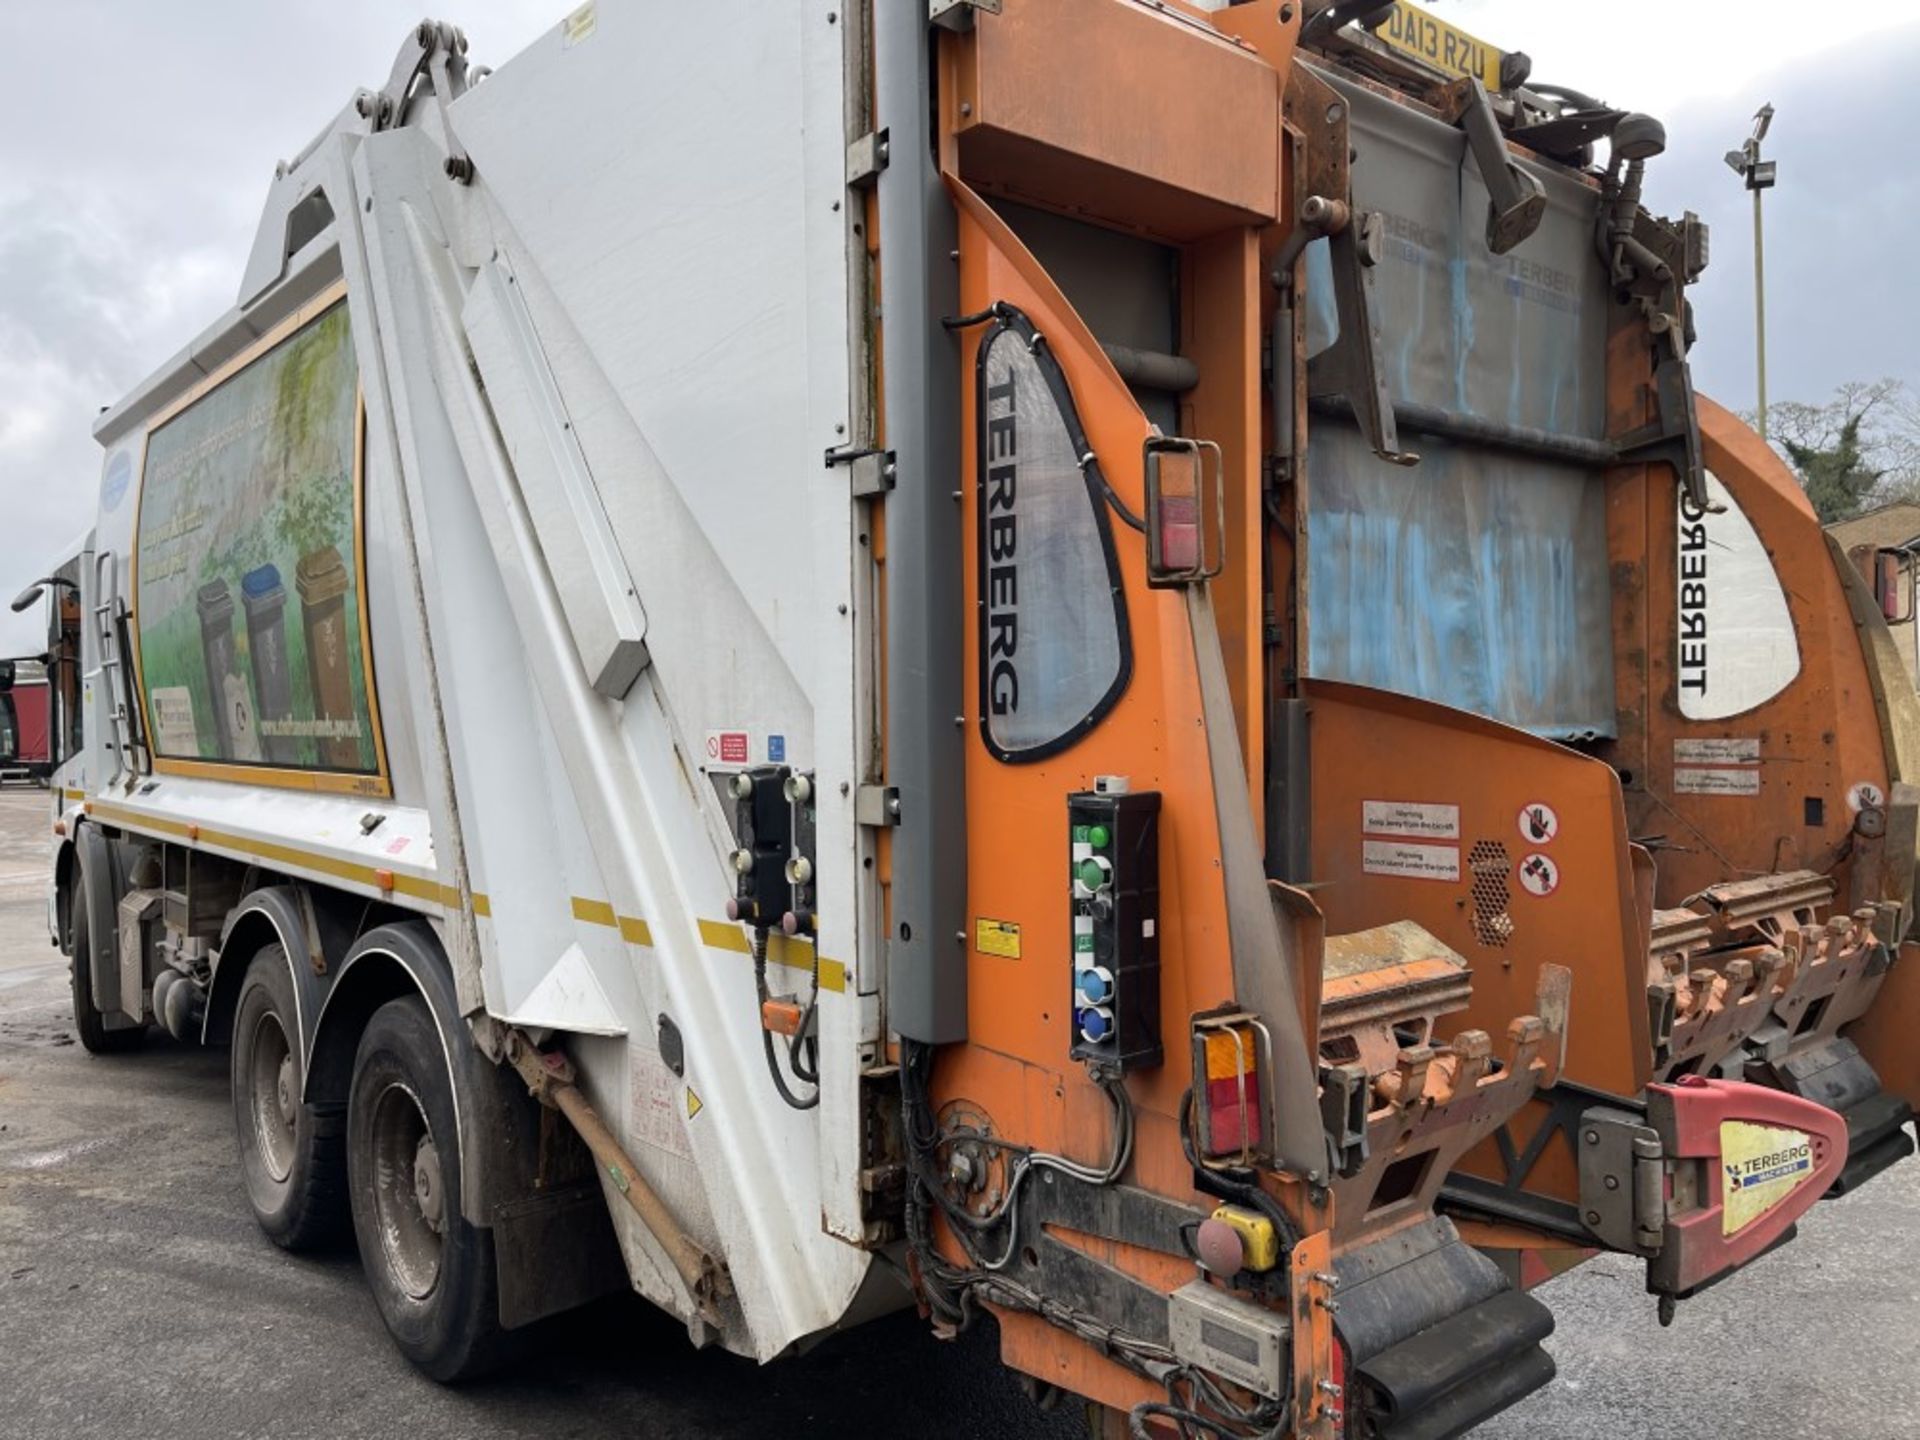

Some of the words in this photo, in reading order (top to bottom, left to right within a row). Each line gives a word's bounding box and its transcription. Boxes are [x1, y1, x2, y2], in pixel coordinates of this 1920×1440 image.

[1389, 3, 1438, 59] DA13
[1444, 30, 1485, 80] RZU
[988, 365, 1019, 716] TERBERG
[1744, 1144, 1810, 1174] TERBERG
